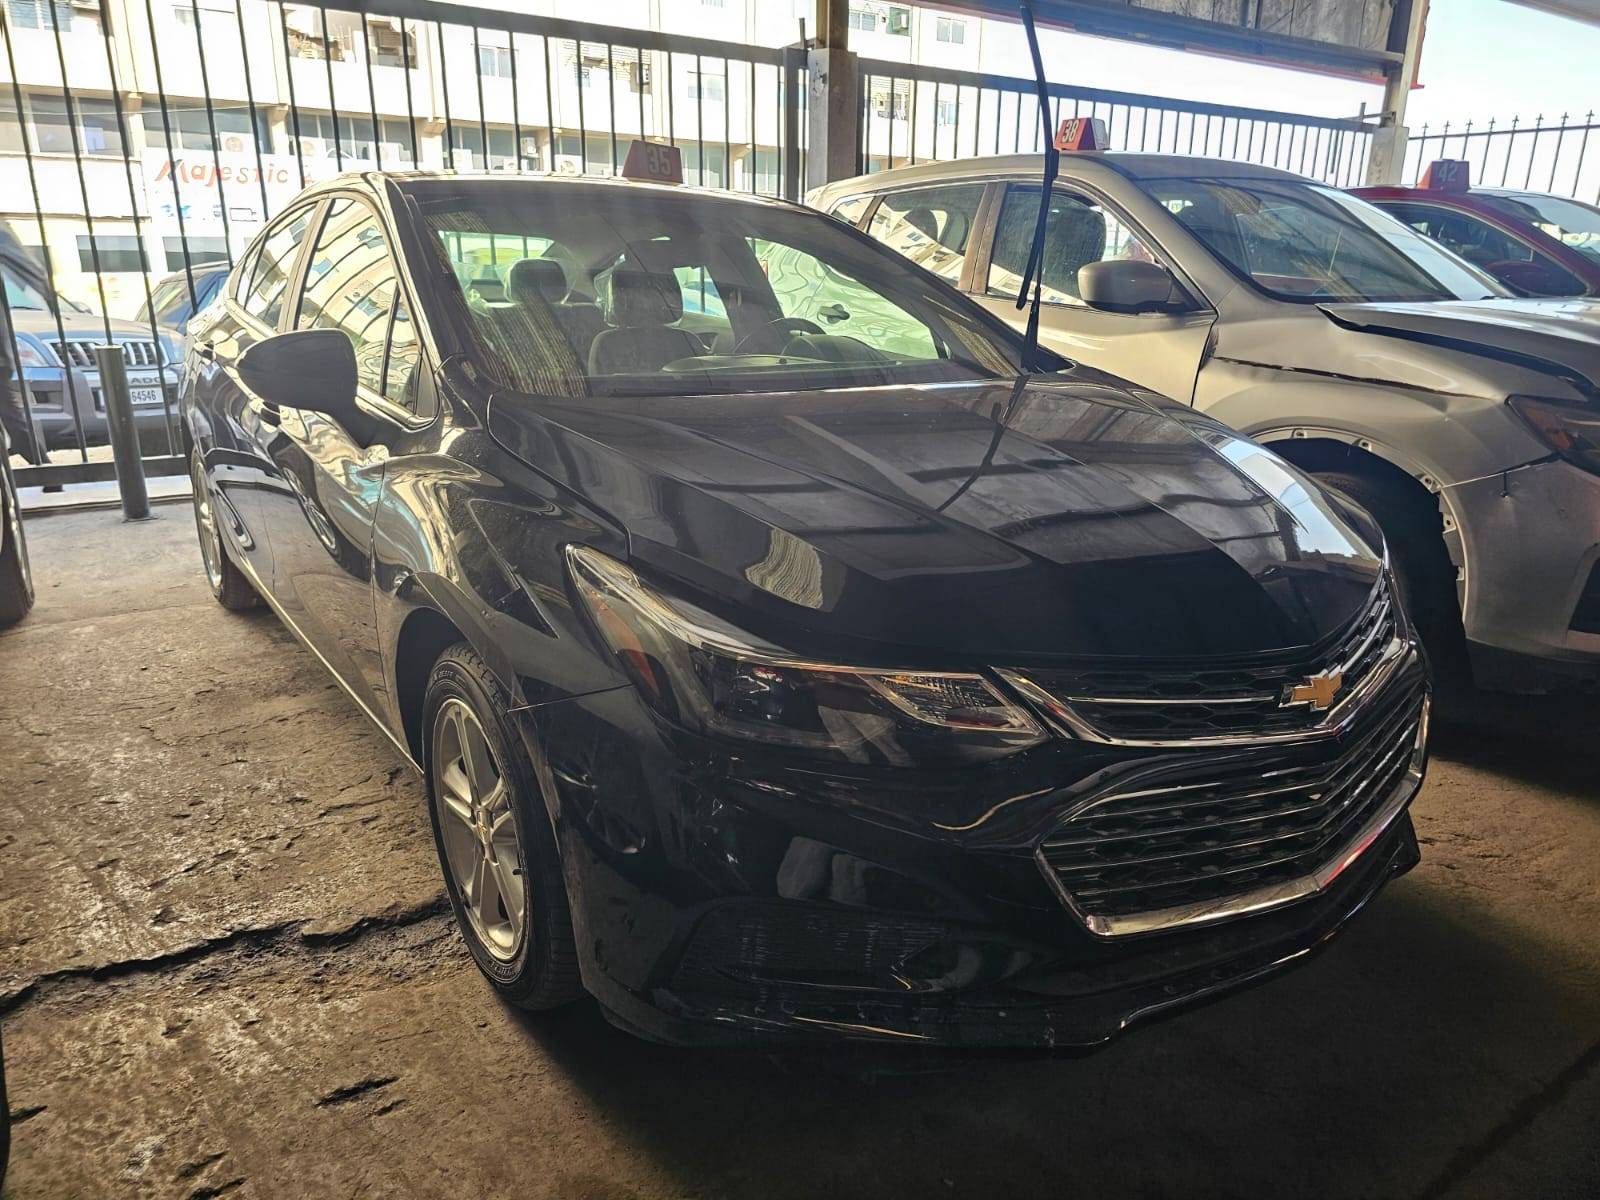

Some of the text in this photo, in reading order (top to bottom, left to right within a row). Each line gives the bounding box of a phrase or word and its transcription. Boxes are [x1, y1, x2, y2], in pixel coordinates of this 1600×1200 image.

[1062, 119, 1080, 143] 38
[154, 158, 289, 187] Majestic
[646, 144, 672, 176] 35
[1439, 161, 1457, 182] 42
